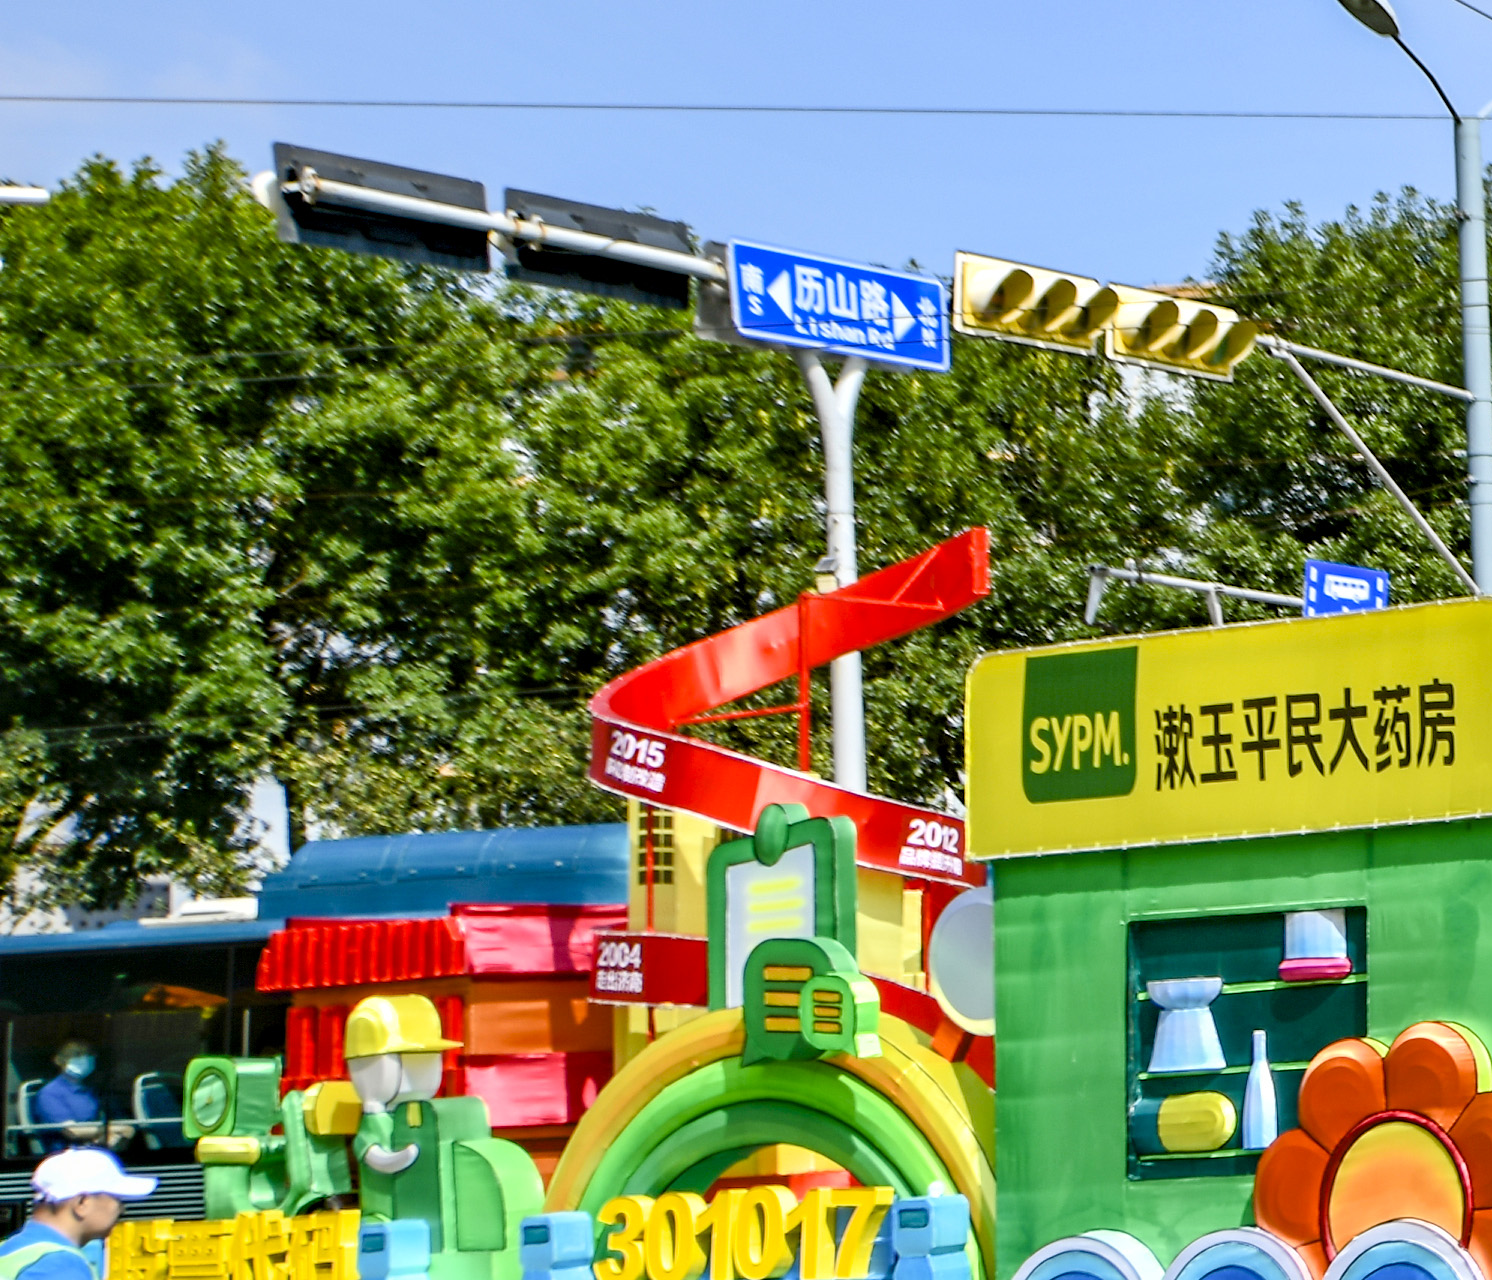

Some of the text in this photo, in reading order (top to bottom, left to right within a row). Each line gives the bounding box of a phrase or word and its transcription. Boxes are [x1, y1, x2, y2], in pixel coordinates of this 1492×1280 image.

[748, 294, 765, 317] S
[794, 264, 890, 328] 历山路
[610, 730, 666, 768] 2015
[1154, 678, 1456, 791] 漱玉平民大药房
[907, 818, 960, 853] 2012
[597, 941, 642, 969] 2004
